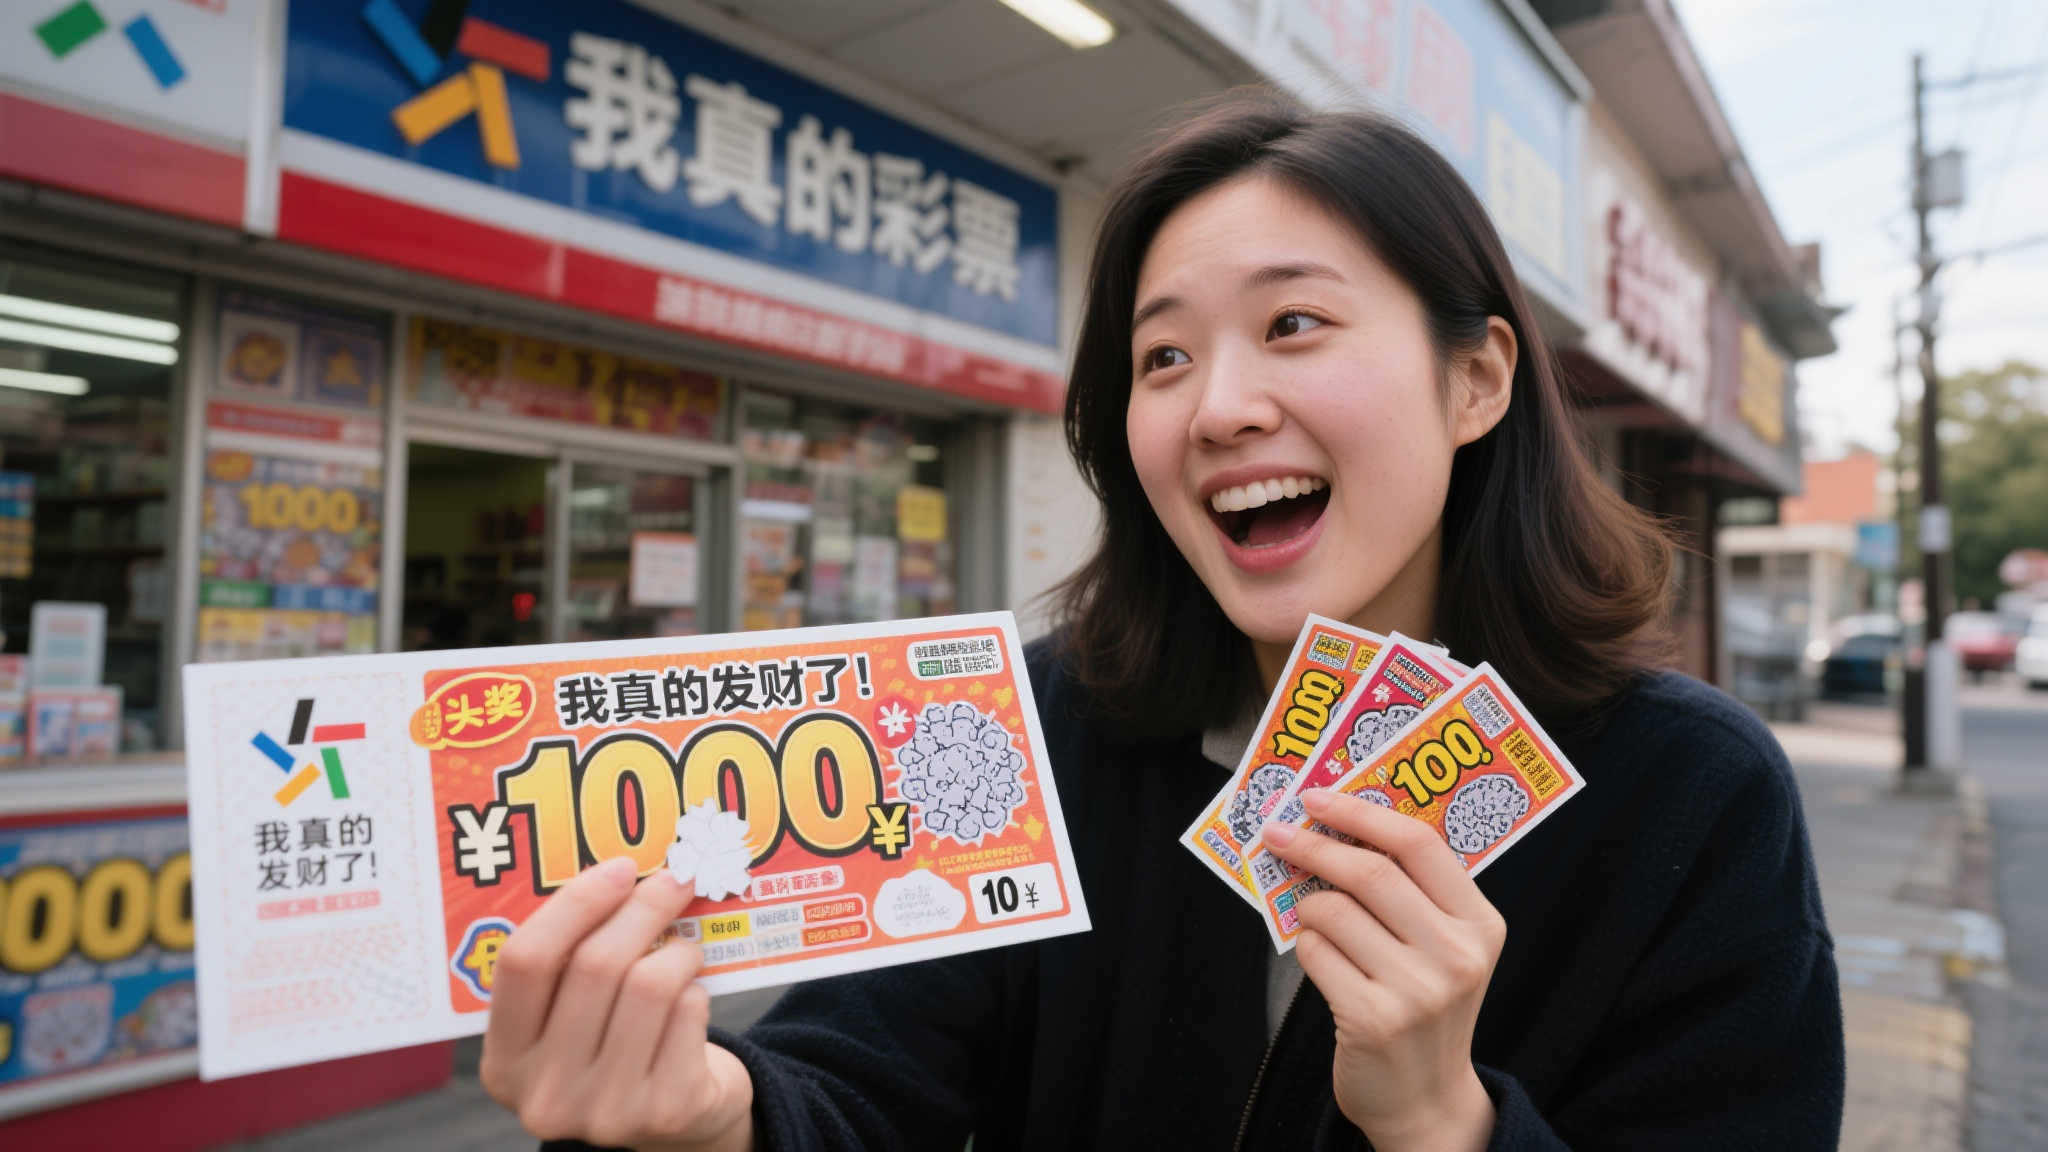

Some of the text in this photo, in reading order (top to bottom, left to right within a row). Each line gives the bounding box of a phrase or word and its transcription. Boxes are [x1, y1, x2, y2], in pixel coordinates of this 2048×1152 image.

[564, 32, 1021, 300] 我真的彩票
[238, 482, 360, 534] 1000
[445, 682, 523, 735] 头奖
[558, 656, 871, 724] 我真的发财了!
[254, 813, 373, 855] 我真的
[257, 851, 377, 890] 发财了!
[982, 876, 1018, 915] 10
